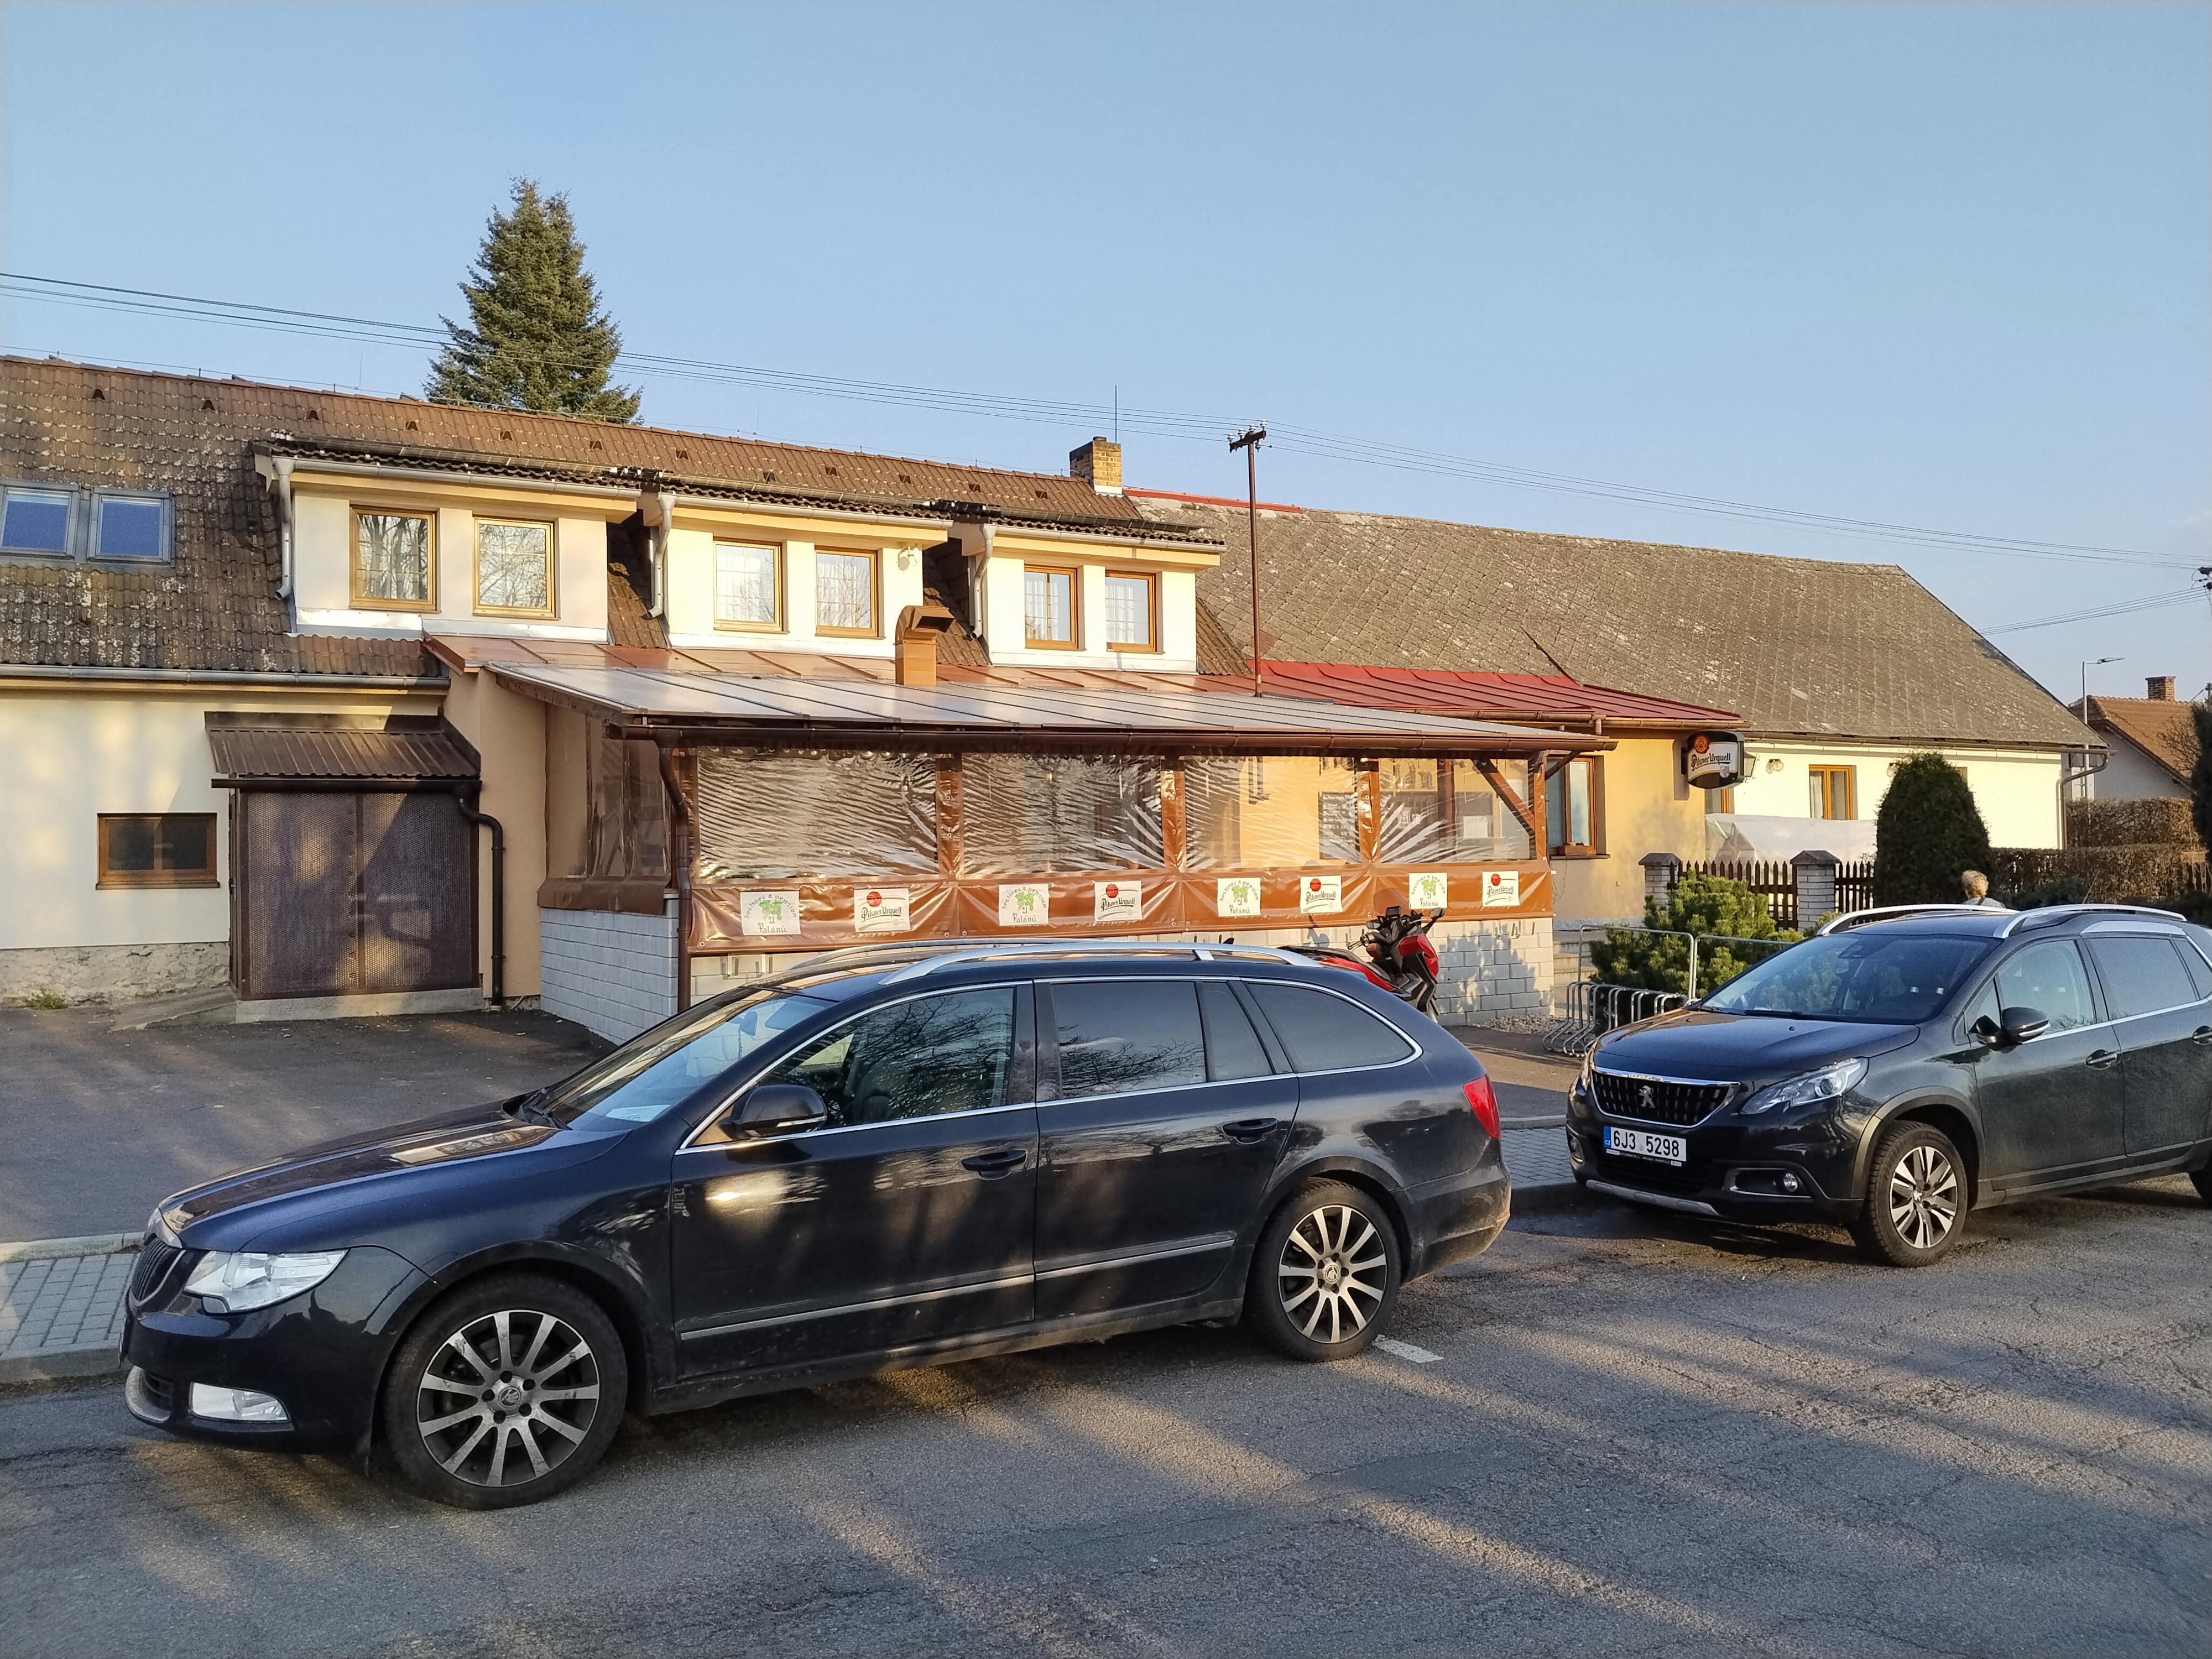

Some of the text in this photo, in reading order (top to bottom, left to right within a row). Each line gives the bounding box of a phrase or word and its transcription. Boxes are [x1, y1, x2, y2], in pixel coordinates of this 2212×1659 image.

[1691, 752, 1731, 771] Pilsner Urquell
[1100, 897, 1135, 912] Pilsner Urquell
[861, 906, 902, 922] Pilsner Urquell
[1614, 1130, 1679, 1157] 6J3 5298
